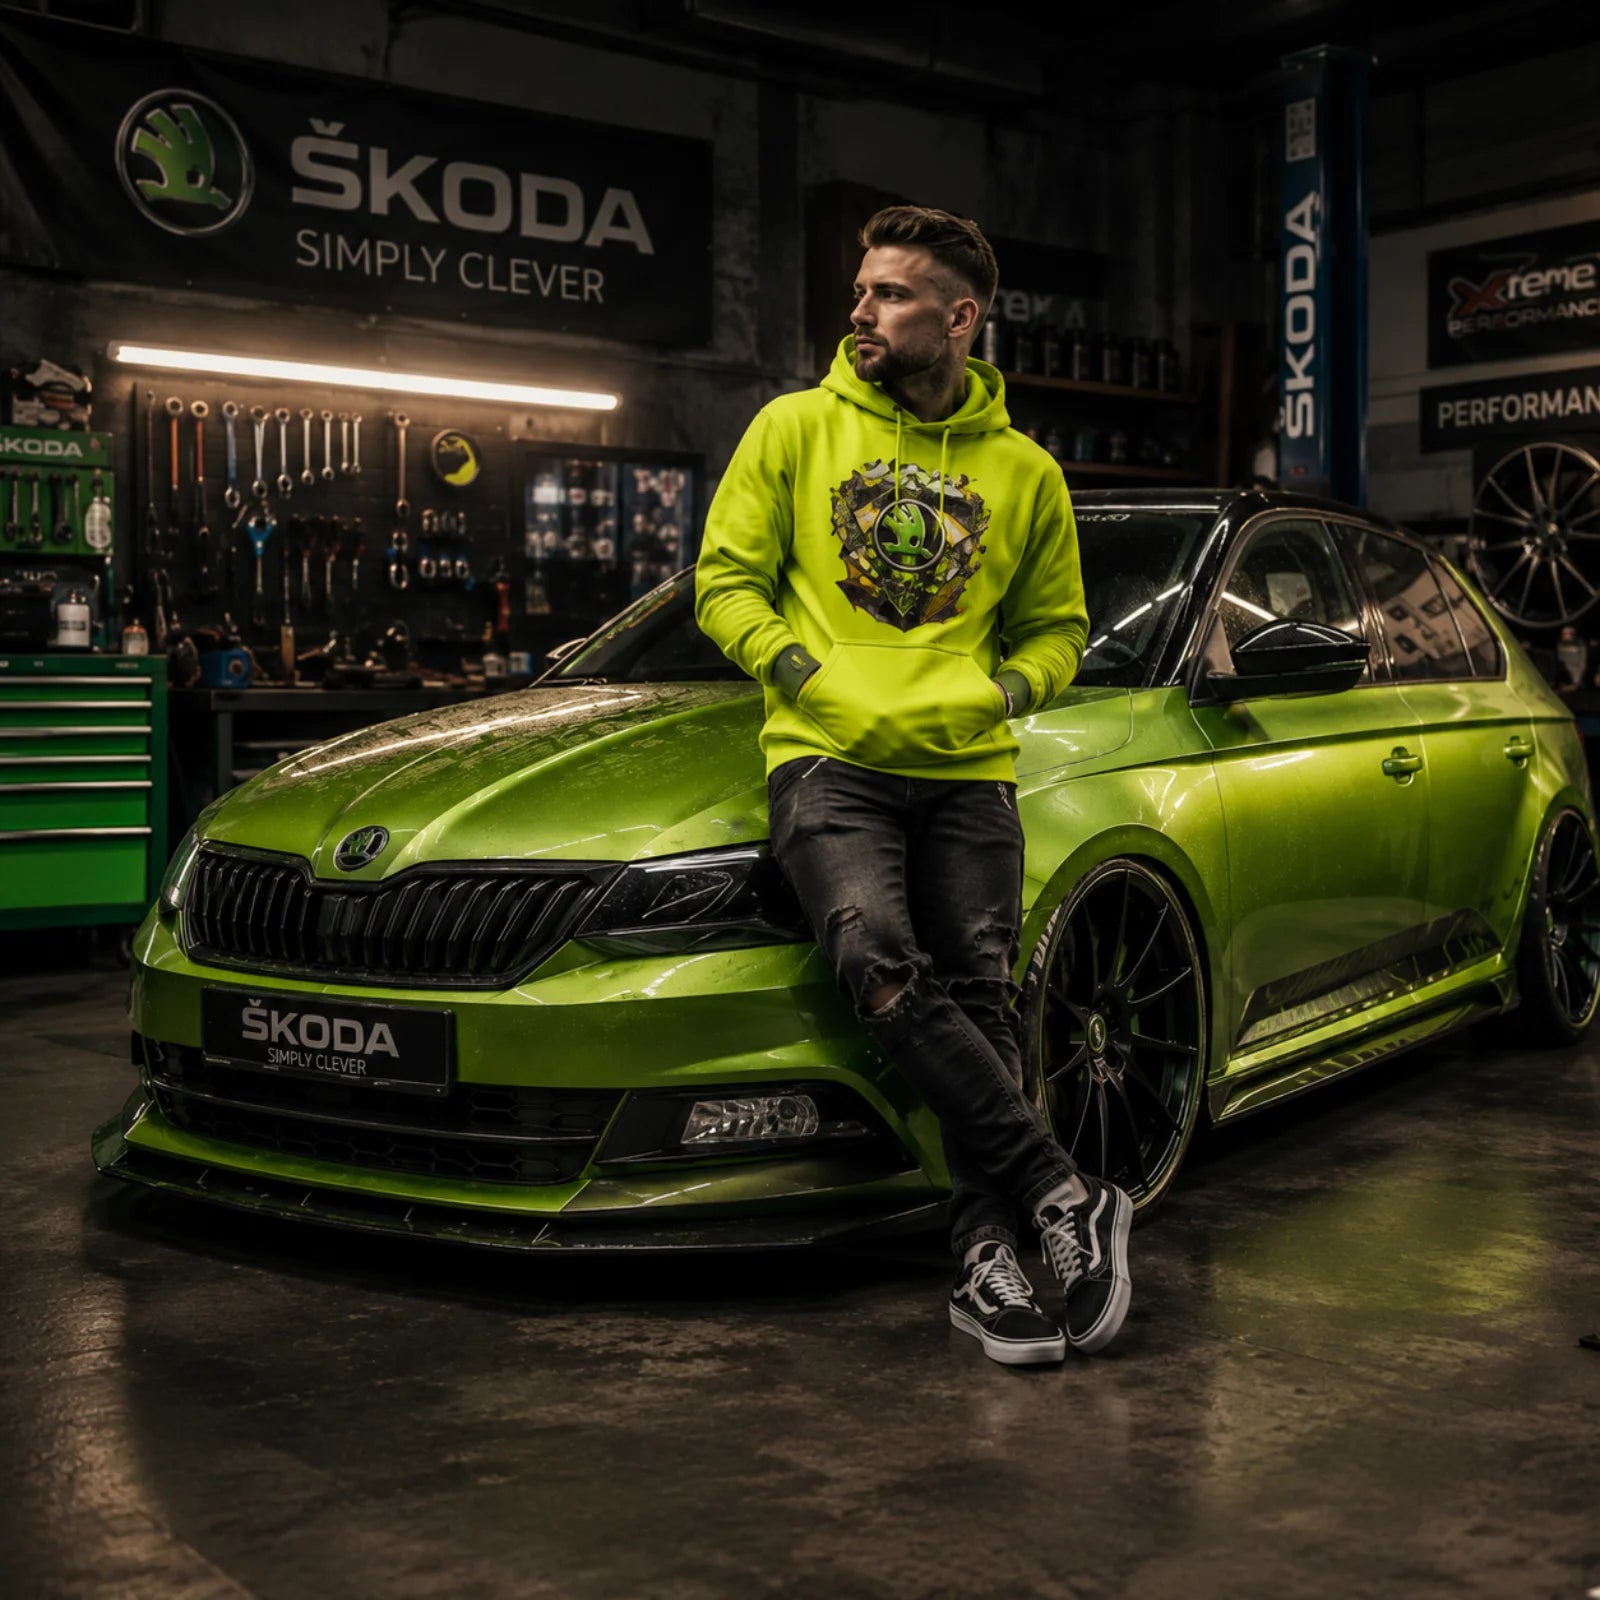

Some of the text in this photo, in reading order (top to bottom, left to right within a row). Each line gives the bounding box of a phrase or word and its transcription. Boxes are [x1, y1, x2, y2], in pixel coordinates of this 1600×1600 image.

[291, 117, 654, 255] ŠKODA
[296, 229, 605, 304] SIMPLY CLEVER
[1274, 190, 1318, 438] ŠKODA
[241, 999, 400, 1058] ŠKODA
[267, 1047, 367, 1075] SIMPLY CLEVER
